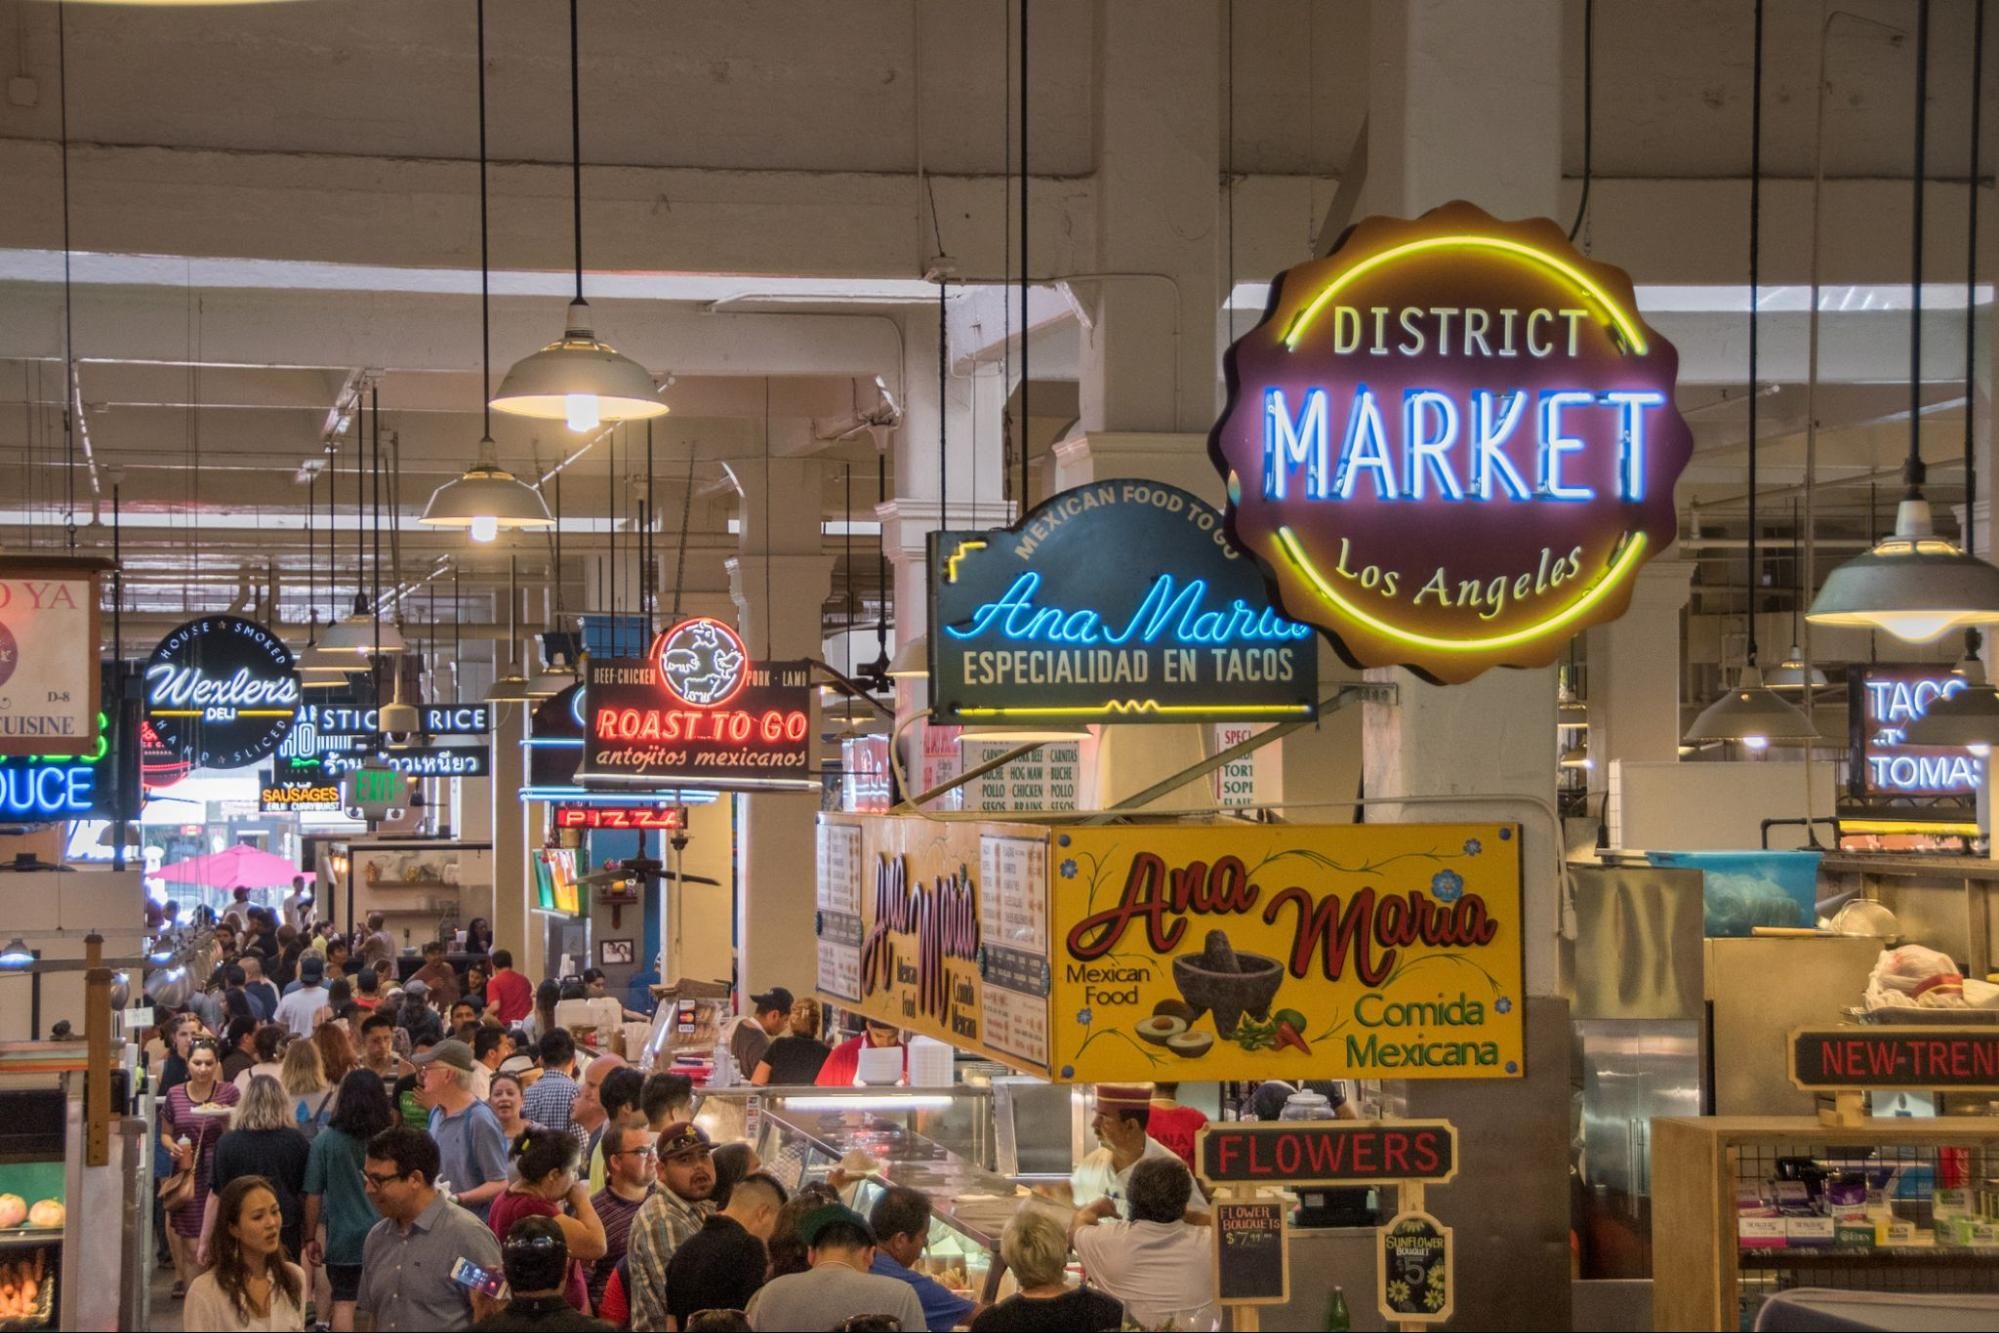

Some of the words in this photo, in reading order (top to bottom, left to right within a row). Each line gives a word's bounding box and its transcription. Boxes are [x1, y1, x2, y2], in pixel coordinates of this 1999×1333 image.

[1334, 306, 1589, 357] DISTRICT
[1264, 386, 1666, 502] MARKET
[1014, 487, 1116, 560] MEXICAN
[1123, 486, 1183, 512] FOOD
[1187, 504, 1214, 530] TO
[1336, 538, 1399, 596] Los
[1413, 546, 1582, 619] Angeles
[24, 582, 77, 609] YA
[947, 572, 1099, 643] Ana
[160, 622, 209, 659] HOUSE
[234, 622, 286, 664] SMOKED
[963, 651, 1148, 685] ESPECIALIDAD
[1164, 649, 1197, 682] EN
[1211, 647, 1294, 682] TACOS
[48, 691, 70, 702] D-8
[146, 663, 298, 705] Wexler's
[0, 716, 74, 736] UISINE
[206, 707, 236, 721] DELI
[323, 710, 377, 730] STIC
[430, 708, 486, 730] RICE
[597, 709, 703, 740] ROAST
[711, 710, 751, 741] TO
[762, 710, 808, 741] GO
[157, 719, 210, 761] HAND
[234, 720, 287, 762] SLICED
[596, 746, 687, 773] antojitos
[695, 747, 806, 767] mexicanos
[263, 787, 339, 802] SAUSAGES
[356, 771, 397, 801] EXIT
[982, 784, 1005, 798] POLLO
[1012, 784, 1043, 798] CHICKEN
[1051, 784, 1074, 798] POLLO
[1066, 851, 1260, 963] Ana
[1262, 886, 1499, 989] Maria
[1066, 964, 1150, 983] Mexican
[1085, 986, 1139, 1005] Food
[1354, 992, 1485, 1028] Comida
[1346, 1032, 1499, 1068] Mexicana
[1822, 1040, 1999, 1077] NEW-TREN
[1218, 1132, 1440, 1174] FLOWERS
[1220, 1207, 1270, 1220] FLOWER
[1223, 1219, 1281, 1231] BOUQUETS
[1386, 1236, 1444, 1249] SUNFLOWER
